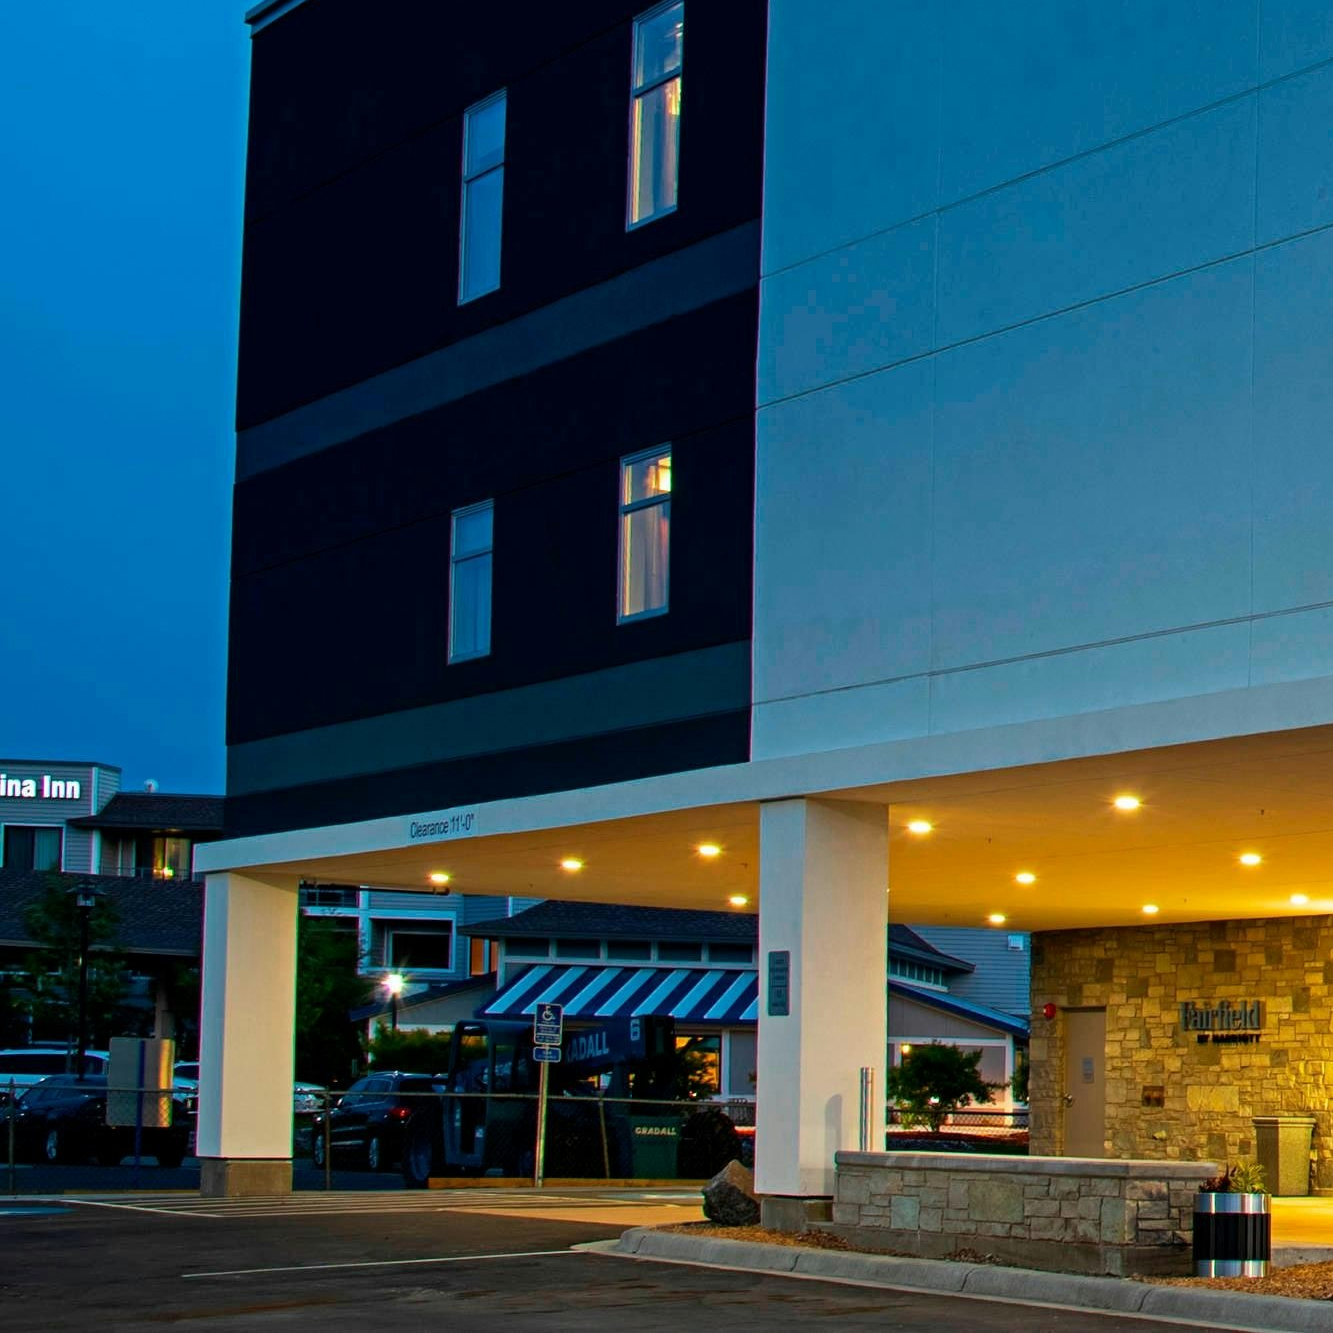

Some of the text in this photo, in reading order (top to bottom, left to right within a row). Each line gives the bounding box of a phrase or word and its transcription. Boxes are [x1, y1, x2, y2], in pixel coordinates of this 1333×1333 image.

[0, 773, 81, 799] ina Inn
[410, 821, 450, 839] Clearance
[1179, 1000, 1261, 1030] Fairfield
